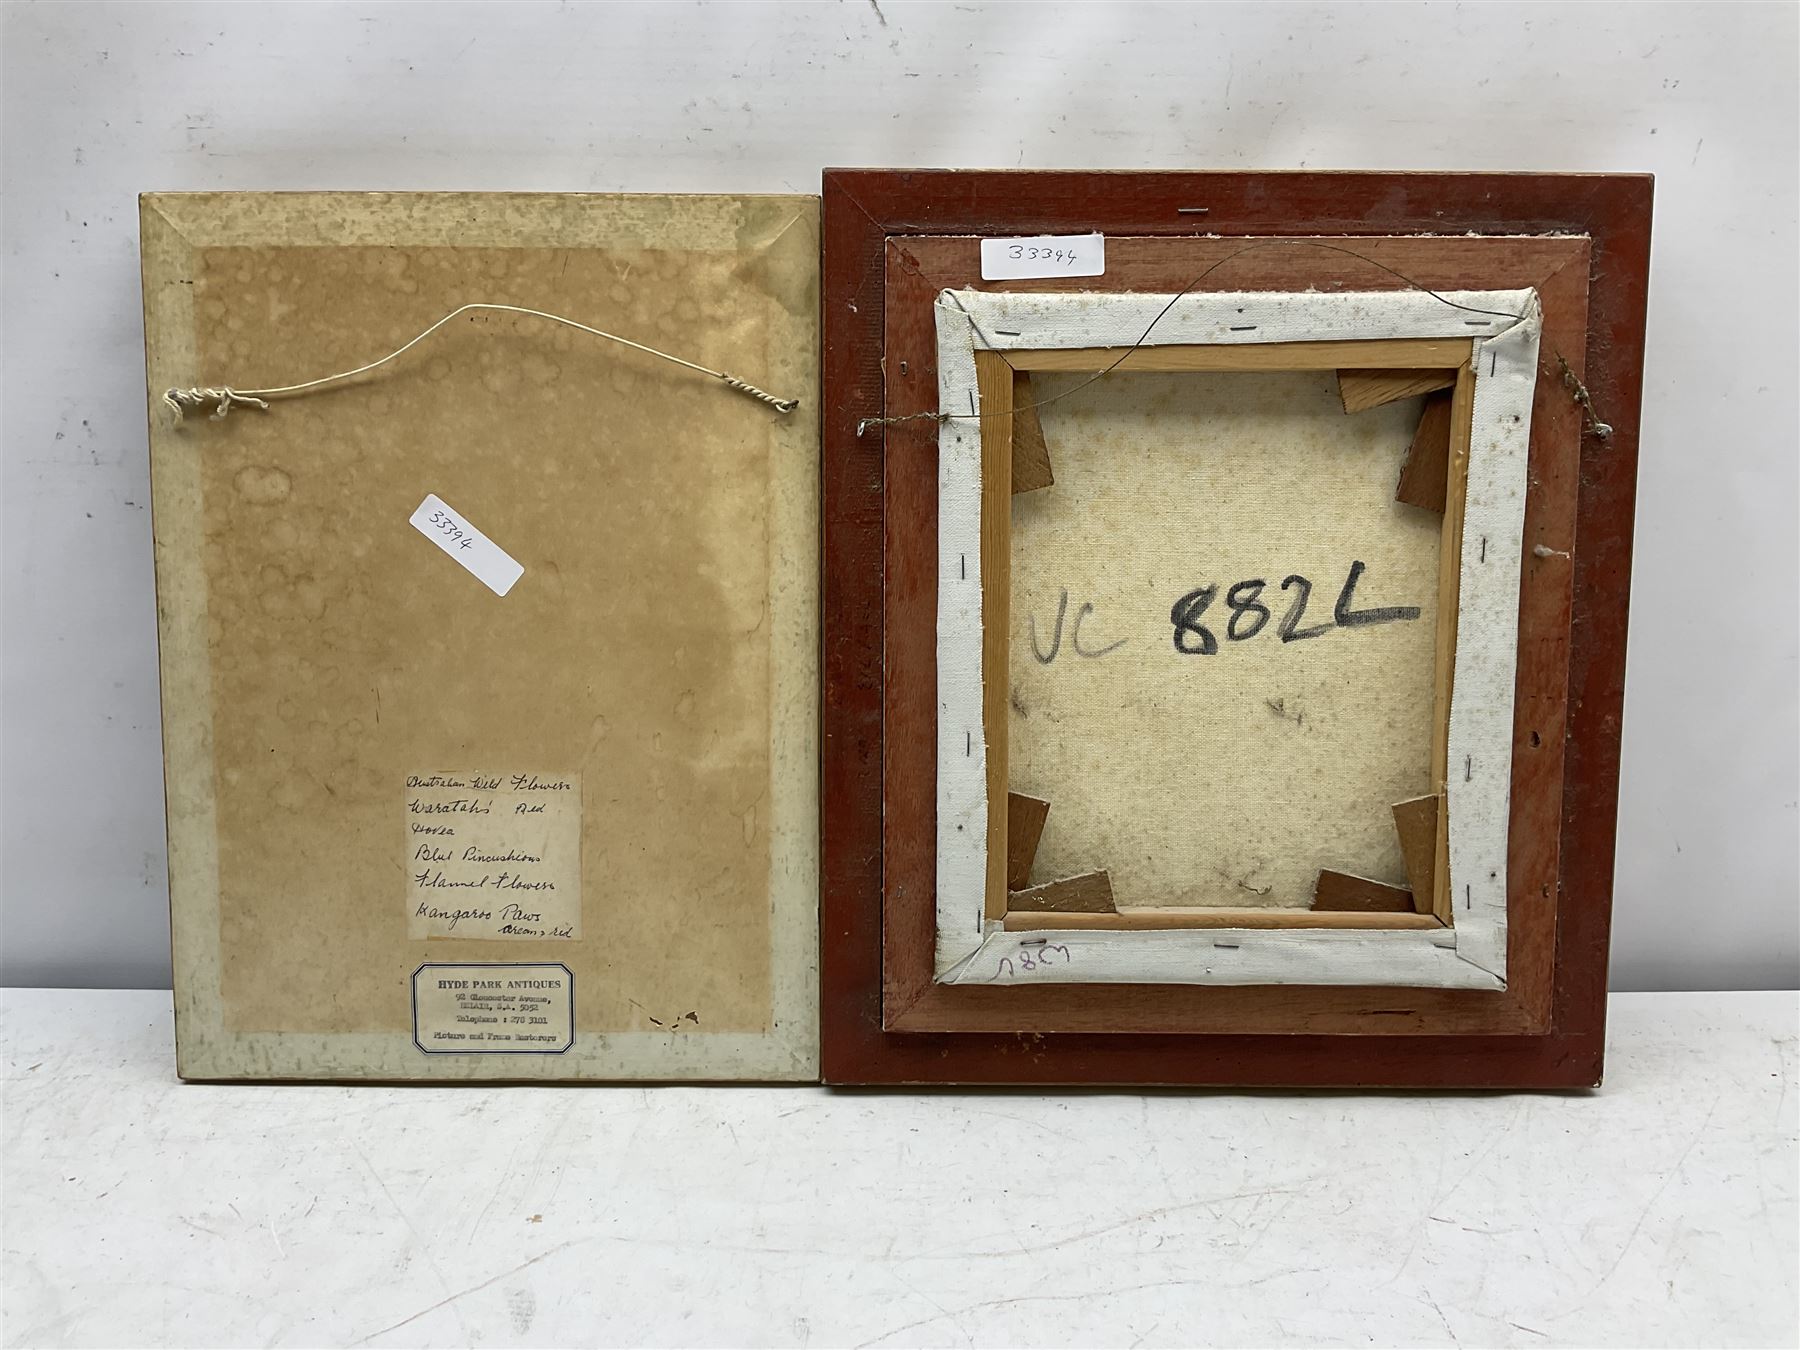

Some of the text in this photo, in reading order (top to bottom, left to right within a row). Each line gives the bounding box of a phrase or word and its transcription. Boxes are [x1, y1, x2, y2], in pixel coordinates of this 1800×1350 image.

[1008, 244, 1077, 266] 33394
[428, 510, 473, 550] 33394
[510, 773, 570, 790] Flowers
[490, 872, 555, 890] Flowers
[415, 902, 491, 930] Kangaroo
[438, 980, 562, 989] HYDE PARK ANTIQUES
